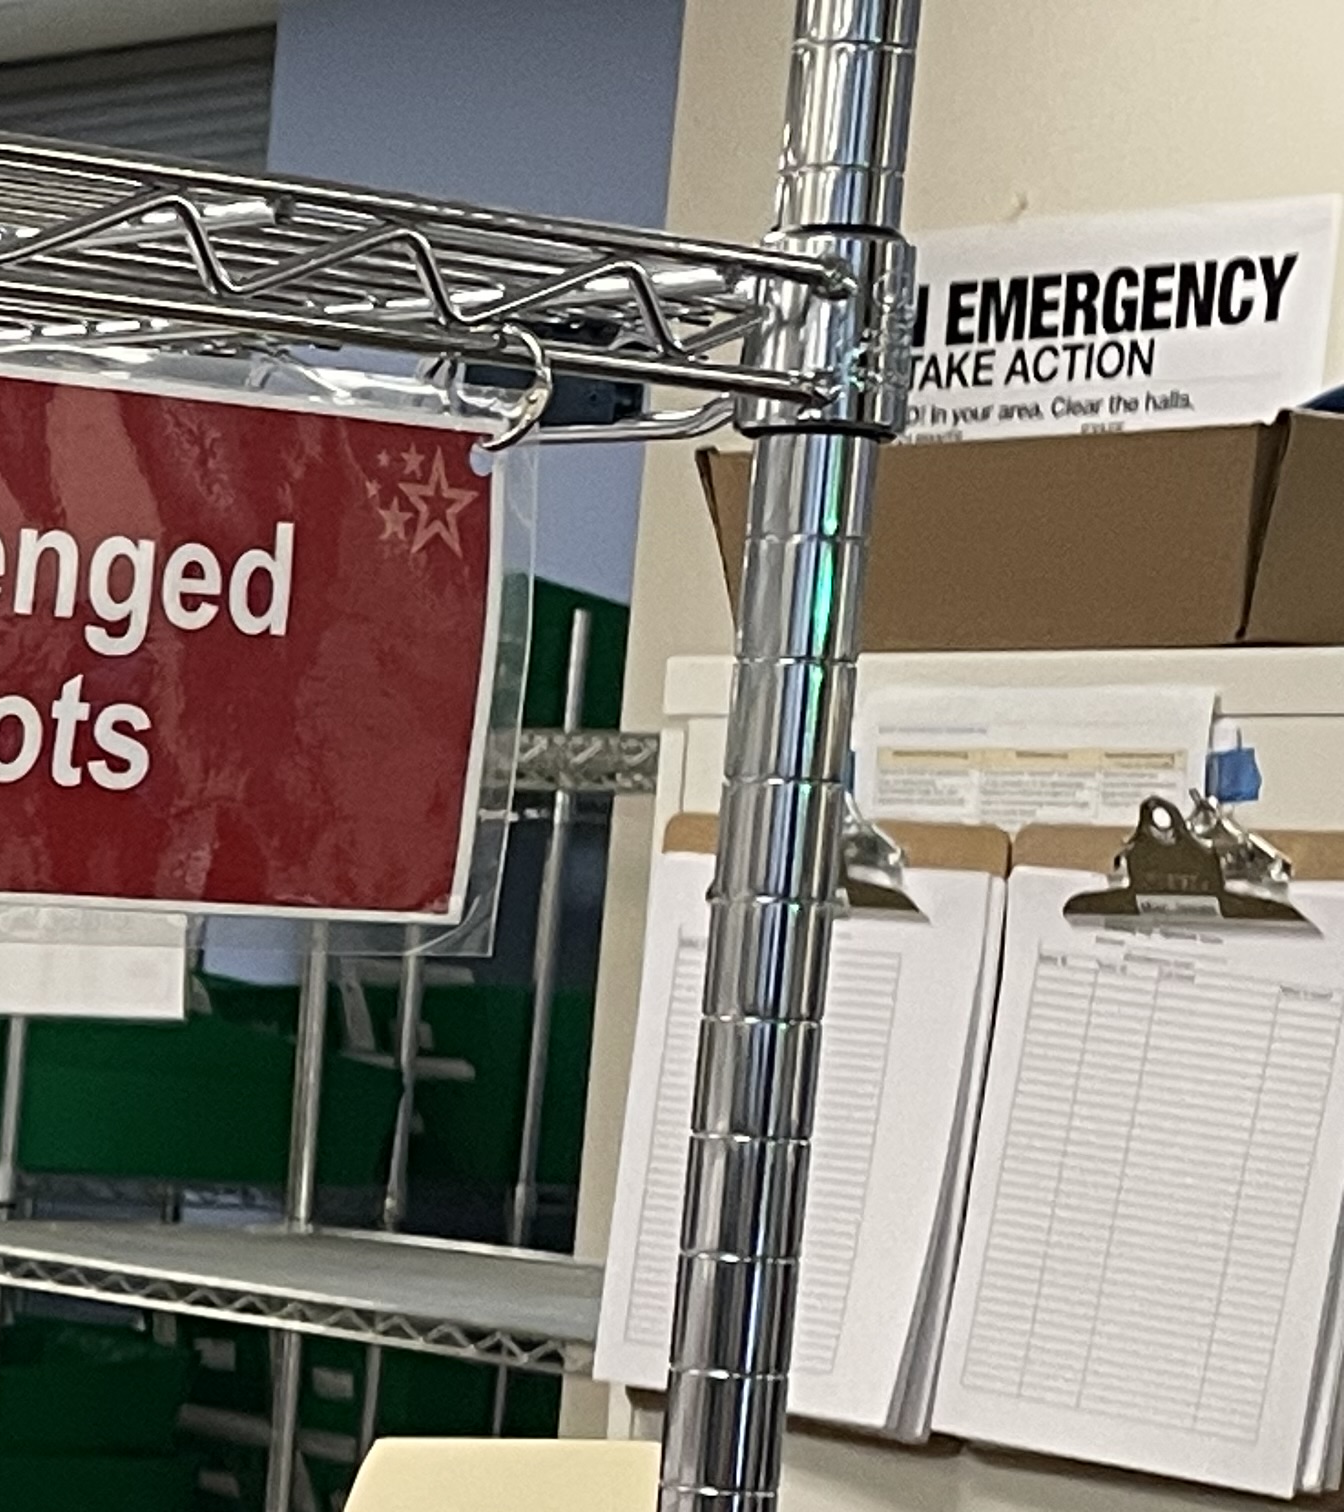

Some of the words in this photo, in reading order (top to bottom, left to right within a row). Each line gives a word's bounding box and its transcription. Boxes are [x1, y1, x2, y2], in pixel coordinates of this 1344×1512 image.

[946, 252, 1299, 346] EMERGENCY
[910, 348, 997, 392] TAKE
[1005, 337, 1156, 387] ACTION
[952, 404, 992, 427] your
[1050, 395, 1104, 420] Clear
[1108, 391, 1141, 414] the
